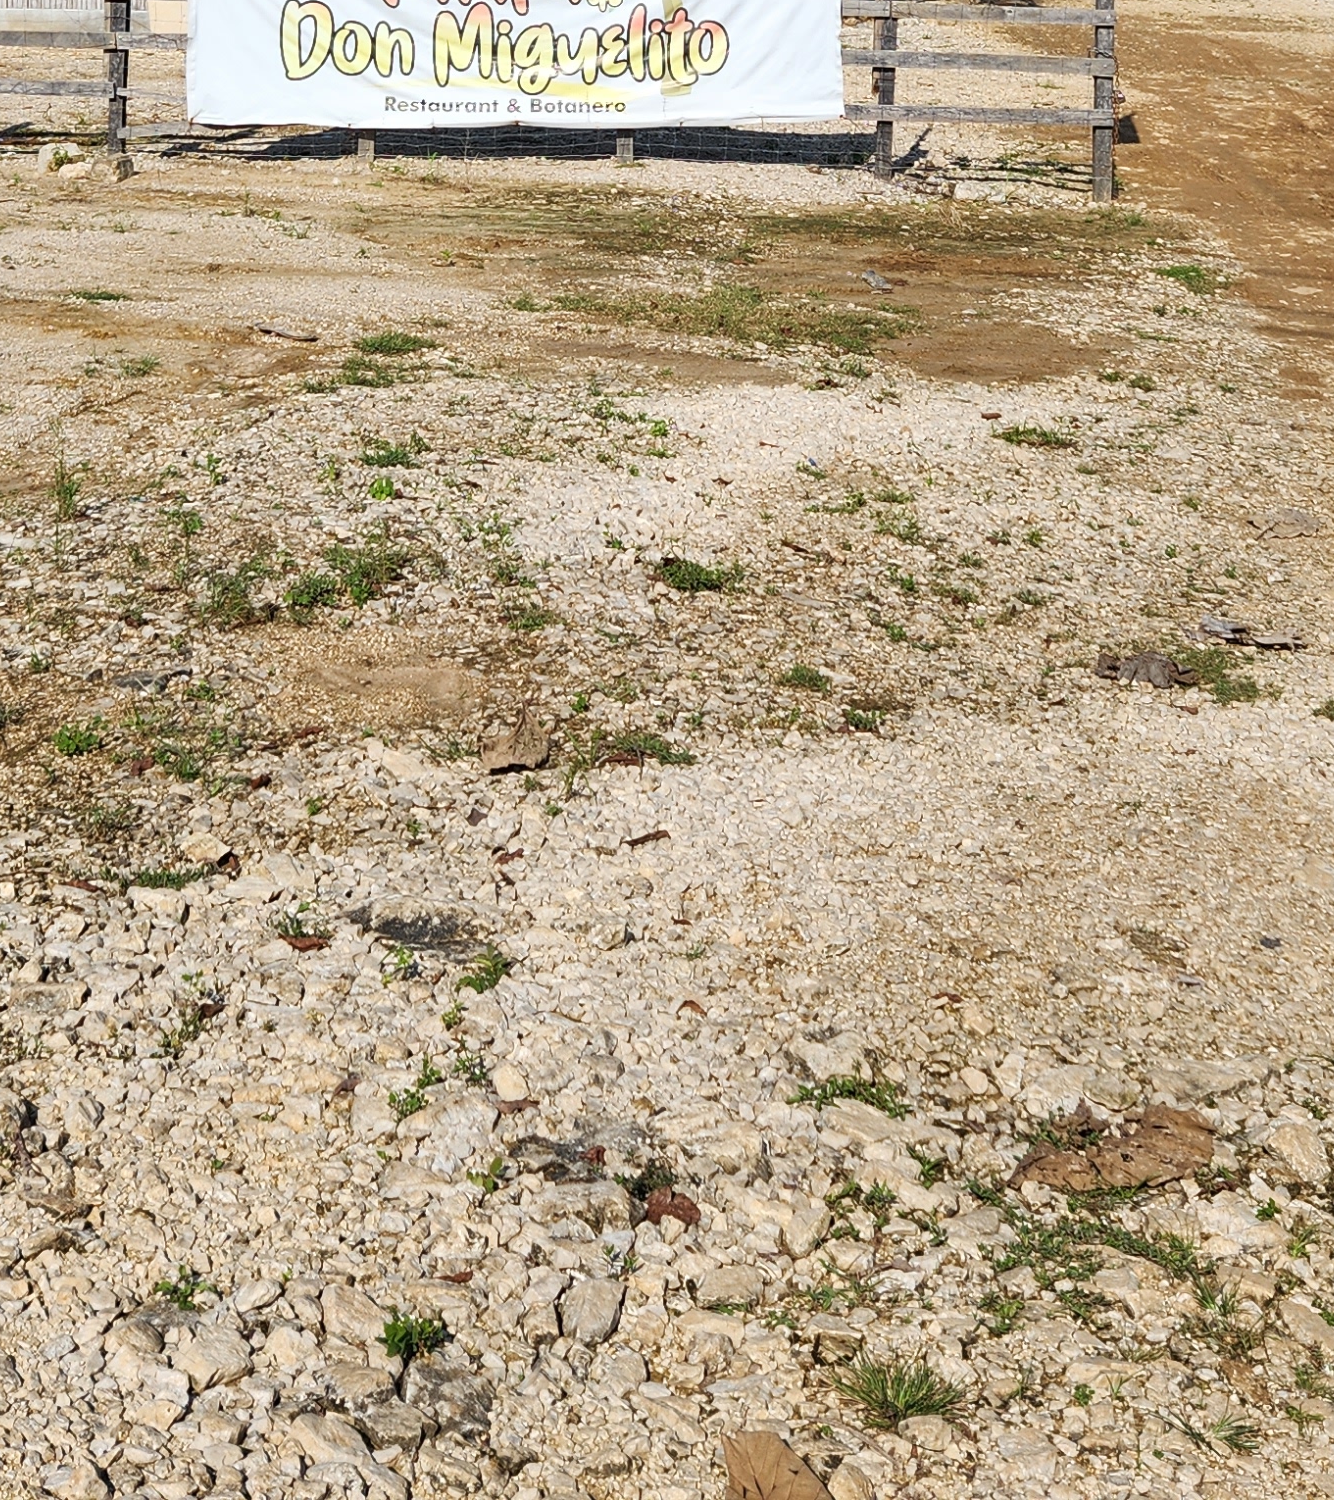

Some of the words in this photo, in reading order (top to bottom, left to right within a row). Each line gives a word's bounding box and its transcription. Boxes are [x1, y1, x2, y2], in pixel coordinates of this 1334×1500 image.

[433, 1, 729, 95] Miguelito
[384, 96, 499, 113] Restaurant
[506, 98, 521, 113] &
[530, 99, 627, 114] Botanero
